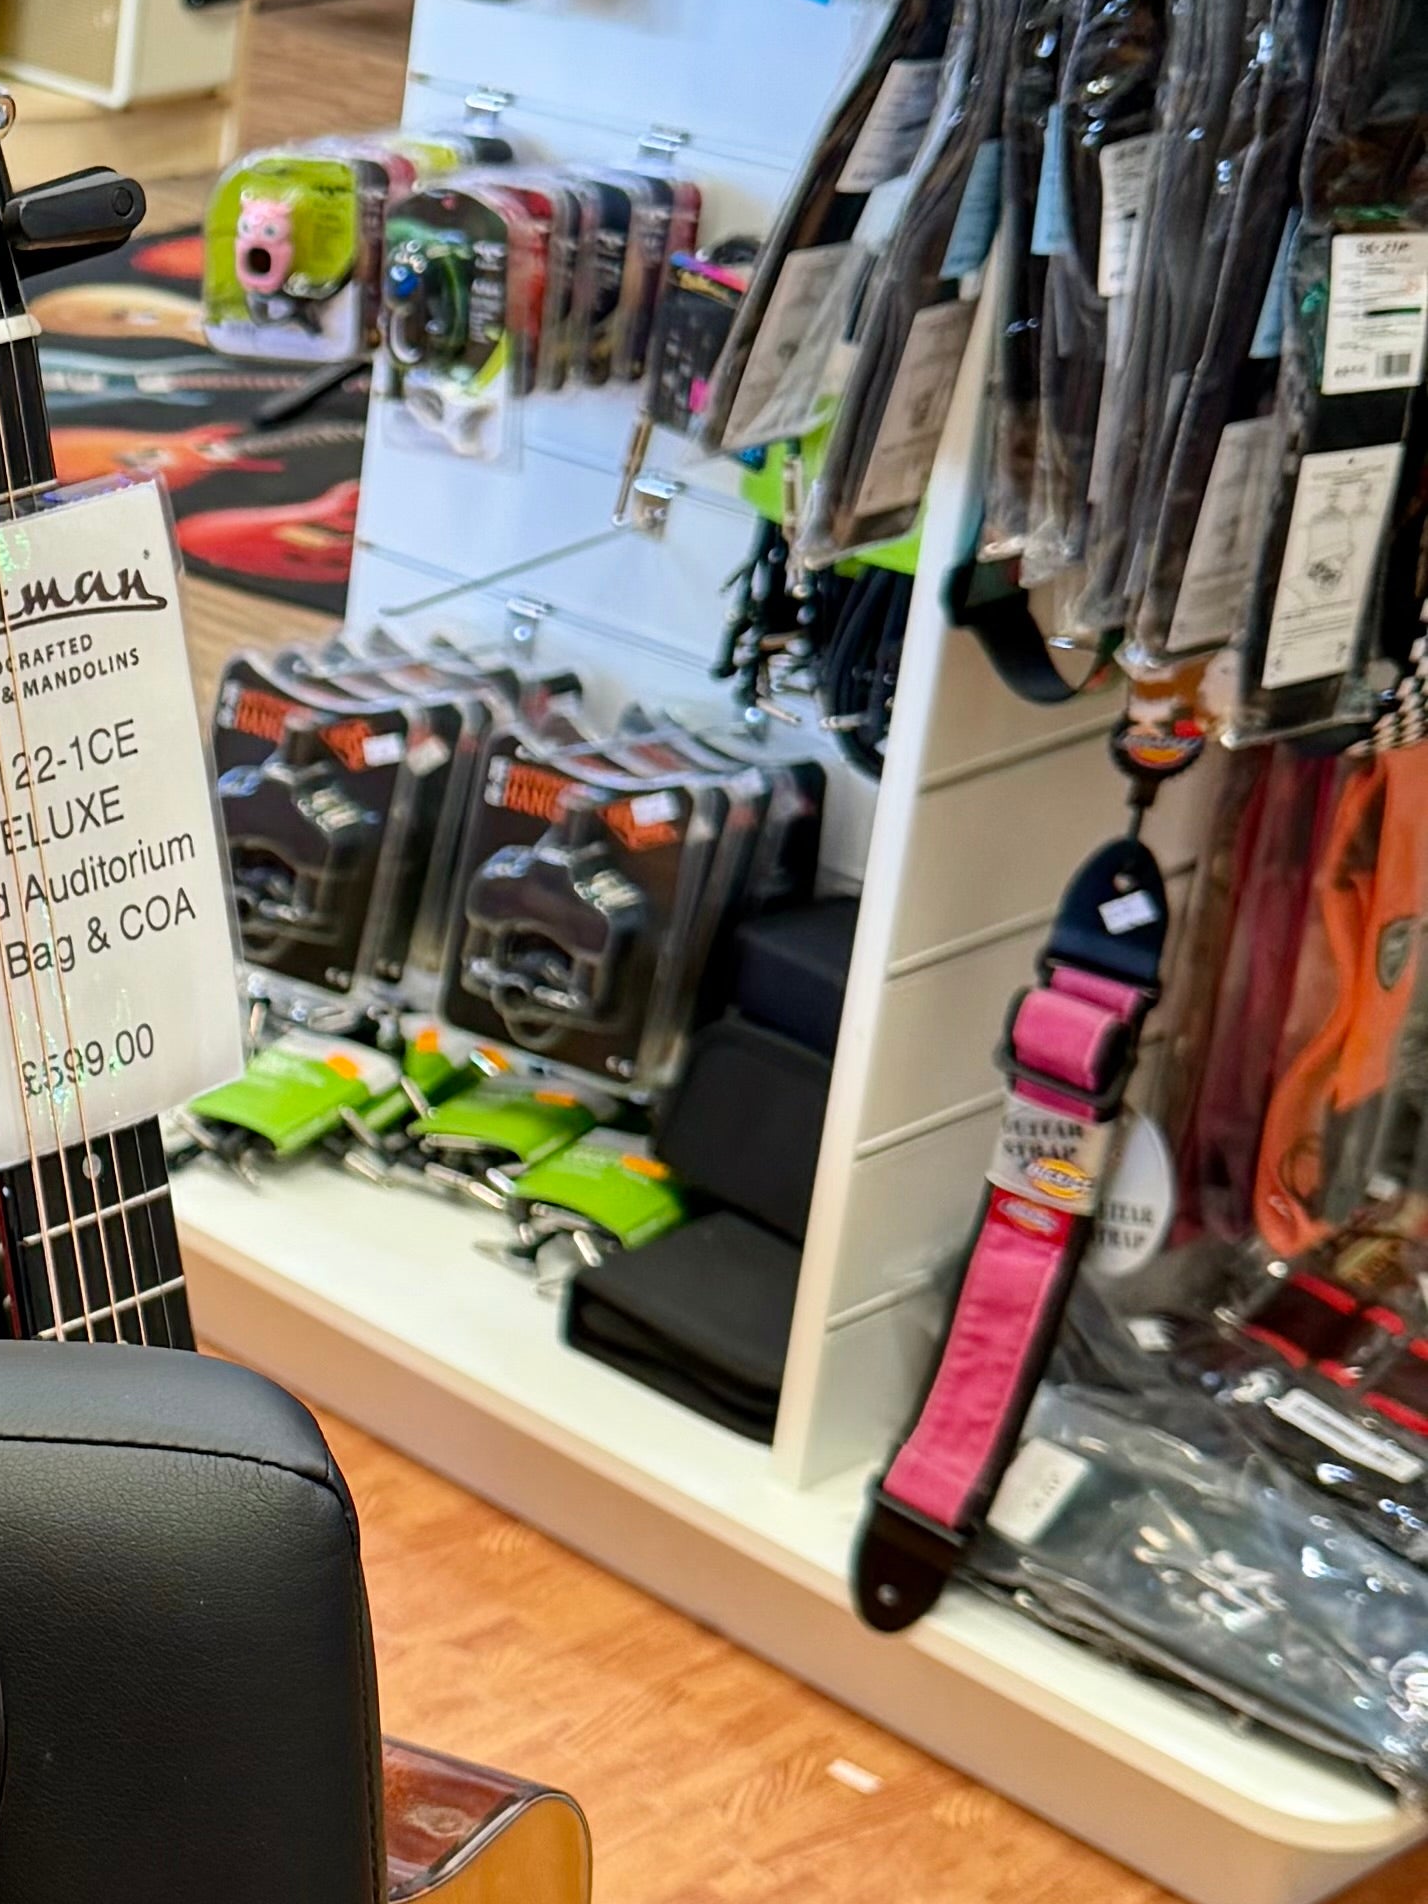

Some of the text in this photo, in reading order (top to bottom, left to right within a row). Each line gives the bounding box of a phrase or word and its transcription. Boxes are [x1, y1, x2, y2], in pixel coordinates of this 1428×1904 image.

[1, 686, 17, 705] &
[22, 648, 140, 700] MANDOLINS
[24, 833, 196, 912] Auditorium
[5, 933, 76, 980] Bag
[87, 915, 111, 955] &
[119, 886, 197, 942] COA
[21, 1022, 155, 1099] £599.00
